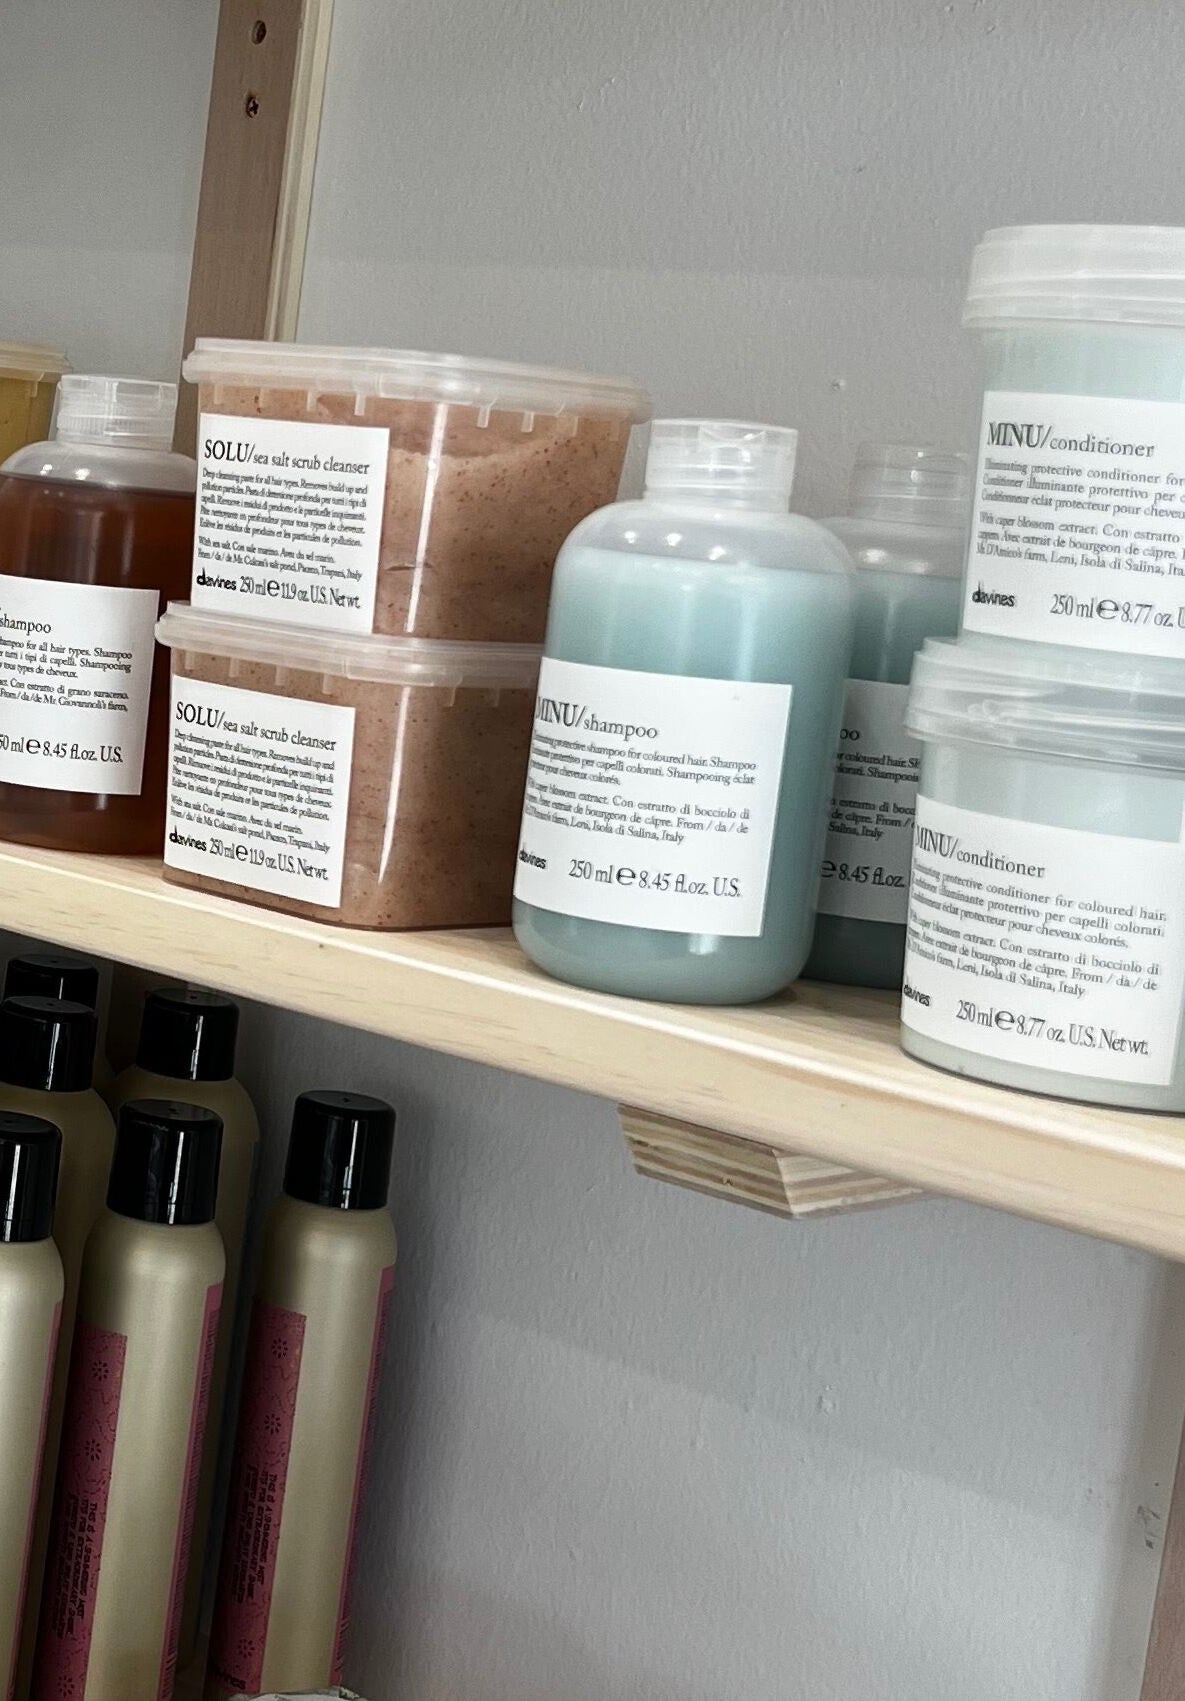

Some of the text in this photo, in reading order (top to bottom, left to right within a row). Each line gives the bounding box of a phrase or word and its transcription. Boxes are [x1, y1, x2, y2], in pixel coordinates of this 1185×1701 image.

[987, 421, 1155, 457] MINU/conditioner
[204, 439, 370, 474] SOLU/sea salt scrub cleanser
[1087, 467, 1160, 484] conditioner
[1089, 486, 1175, 504] protettivo per
[1113, 504, 1141, 516] pour
[1103, 523, 1128, 538] Con
[1125, 543, 1139, 555] de
[1109, 558, 1121, 570] di
[1124, 558, 1165, 576] Salina,
[197, 567, 236, 590] davines
[240, 576, 253, 593] 250
[972, 580, 1174, 627] davines 250 ml 8.77 oz.
[94, 647, 132, 661] Shampoo
[176, 701, 336, 751] SOLU/sea salt scrub cleanser
[11, 737, 24, 753] ml
[43, 742, 67, 758] 8.45
[100, 746, 122, 763] U.S.
[642, 750, 685, 765] coloured
[709, 756, 756, 772] Shampoo
[666, 766, 730, 786] Shampooing
[612, 795, 750, 819] Con di bocciolo di
[630, 812, 749, 833] de From de
[169, 825, 206, 851] davines
[210, 837, 223, 857] 250
[661, 829, 684, 846] Italy
[569, 859, 592, 879] 250
[595, 865, 612, 883] ml
[639, 871, 671, 890] 8.45
[713, 877, 741, 897] U.S.
[838, 863, 870, 883] 8.45
[985, 885, 1167, 921] conditioner for coloured hair.
[987, 900, 1109, 930] protettivo per capelli
[1008, 920, 1082, 941] pour cheveux
[999, 938, 1159, 975] Con estratto di bocciolo di
[1019, 958, 1158, 991] de From de
[1019, 972, 1056, 993] Salina,
[1058, 980, 1086, 999] Italy
[956, 999, 976, 1021] 250
[977, 1007, 993, 1027] ml
[1016, 1014, 1046, 1038] 8.77
[1046, 1027, 1065, 1043] oz.
[1068, 1023, 1096, 1048] U.S.
[1098, 1028, 1127, 1052] Net
[1127, 1040, 1148, 1055] wt.
